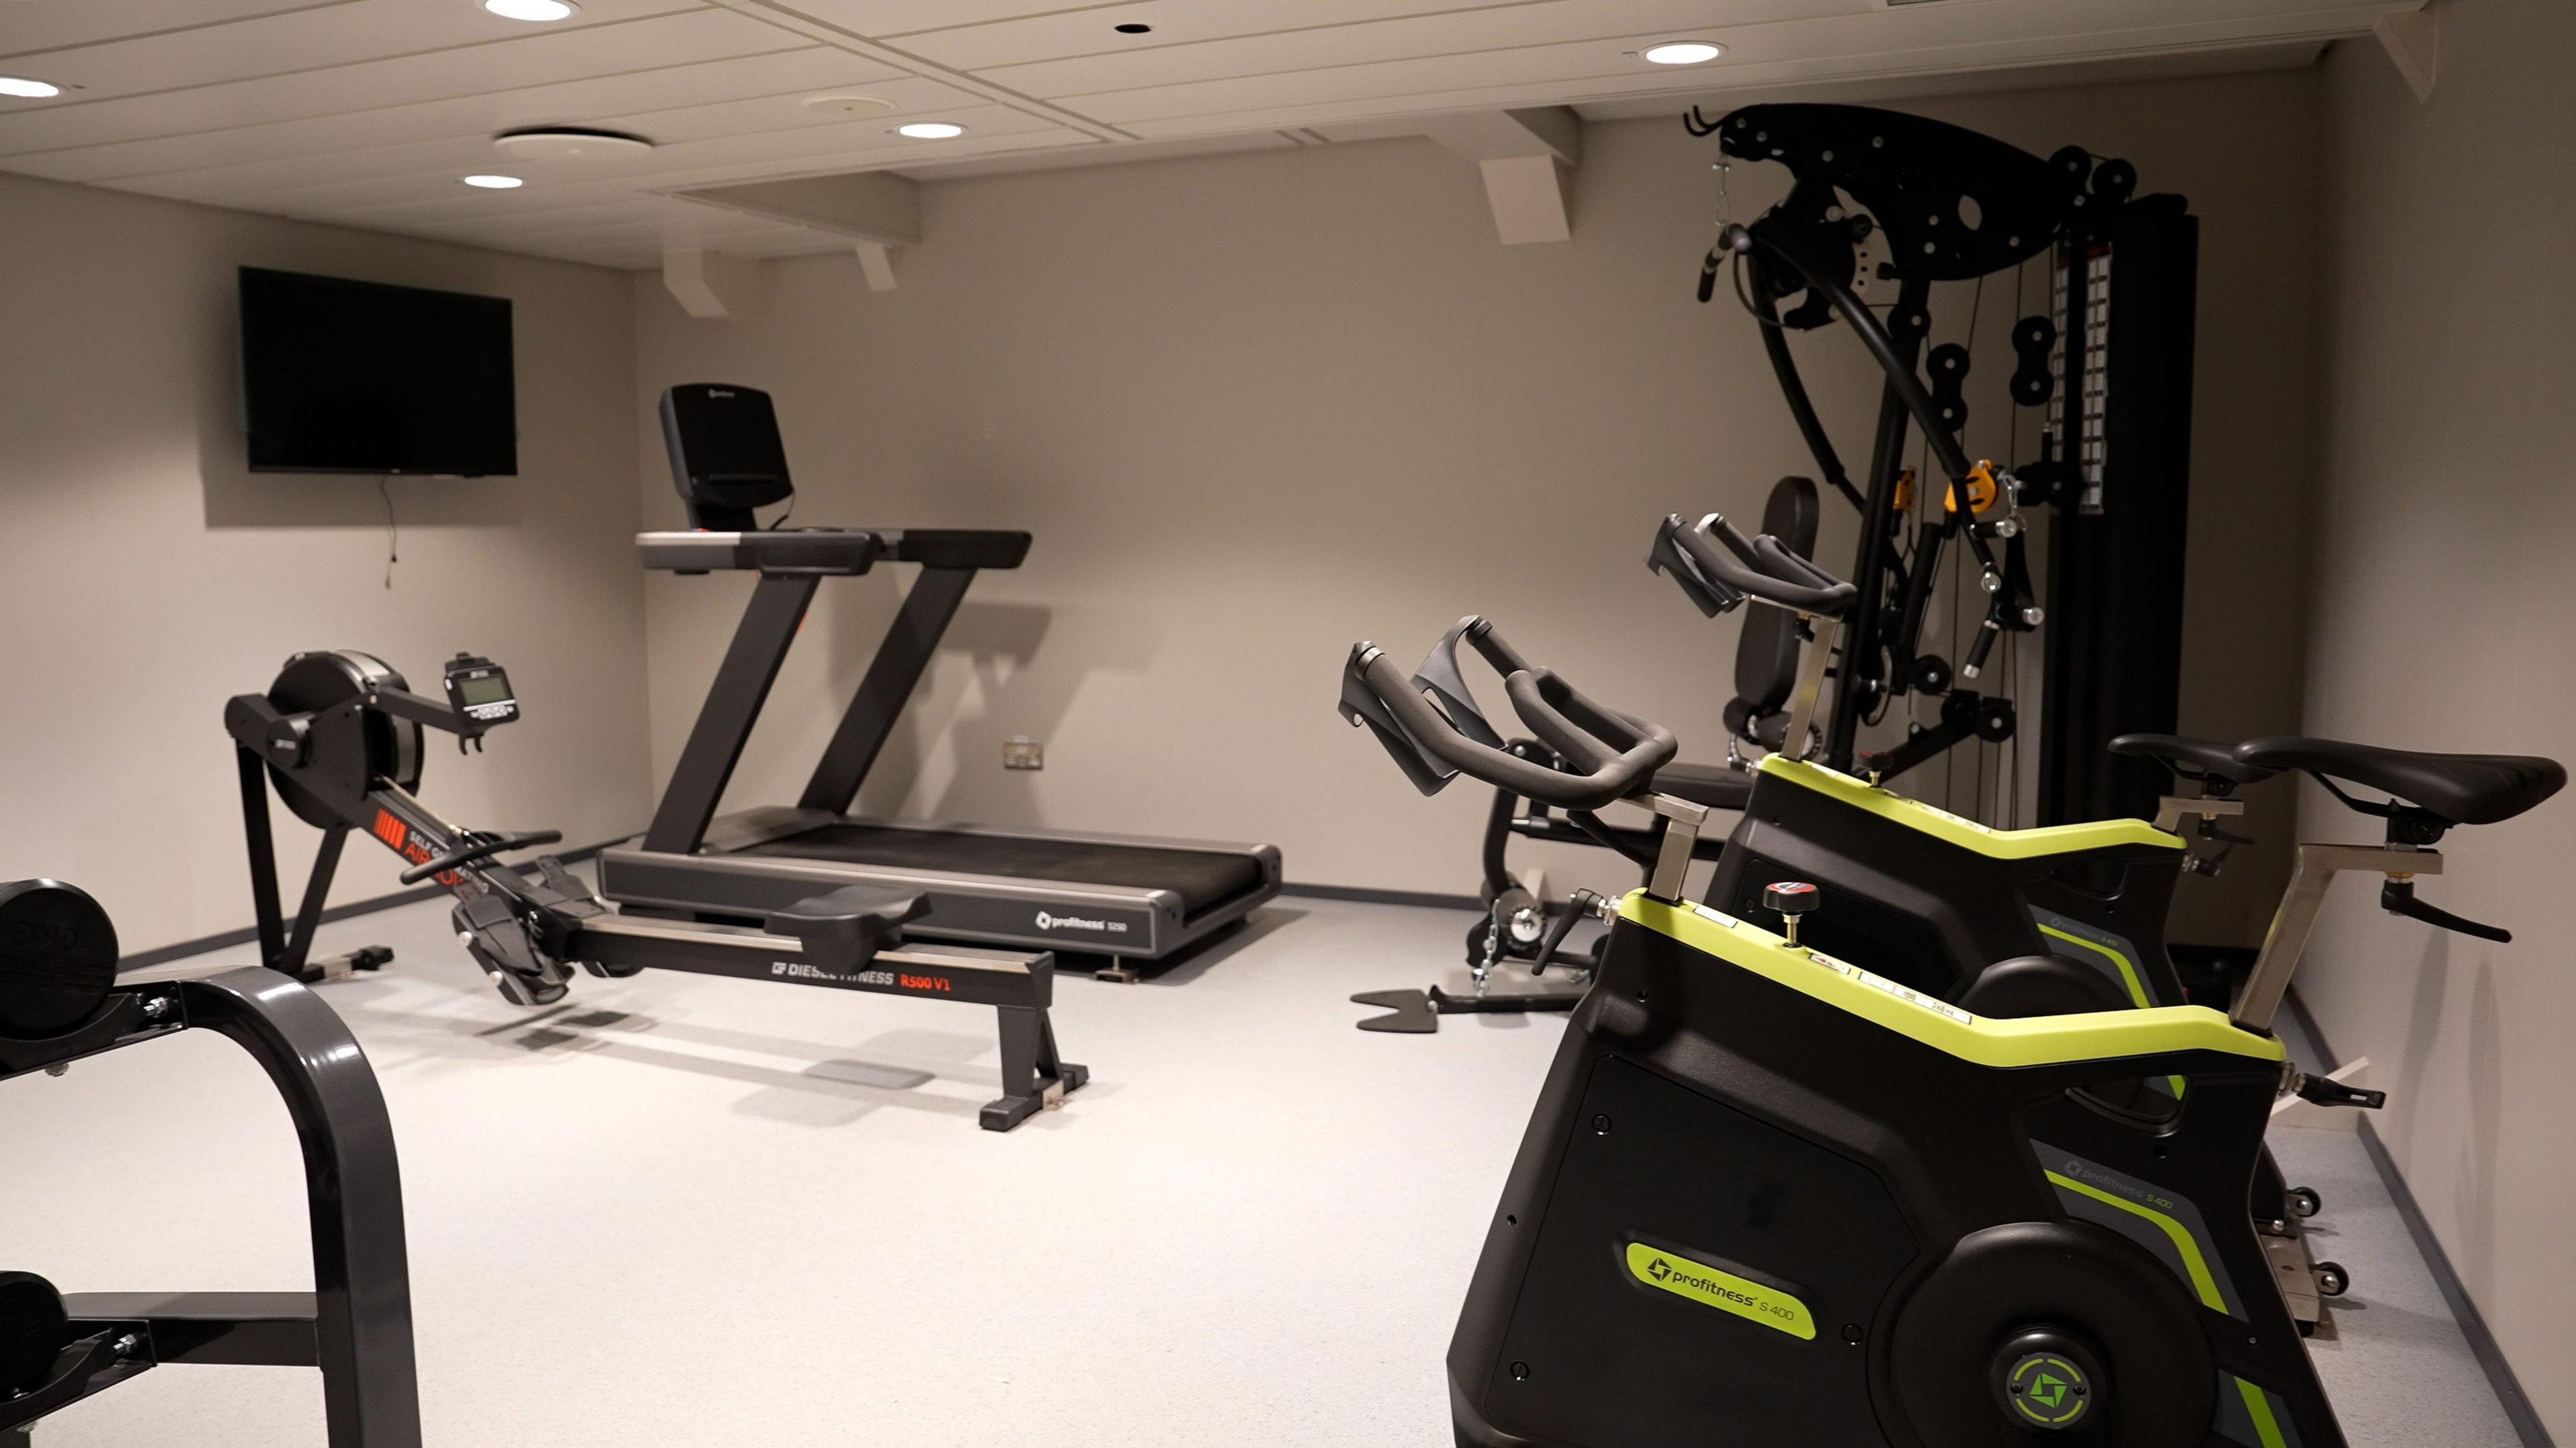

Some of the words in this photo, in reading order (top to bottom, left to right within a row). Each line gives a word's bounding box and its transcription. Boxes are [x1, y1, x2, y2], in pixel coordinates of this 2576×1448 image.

[409, 830, 433, 851] SELF
[900, 974, 932, 989] R500
[933, 977, 951, 992] V1
[1672, 1271, 1754, 1307] profitness
[1759, 1302, 1768, 1313] S
[1770, 1306, 1795, 1321] 400
